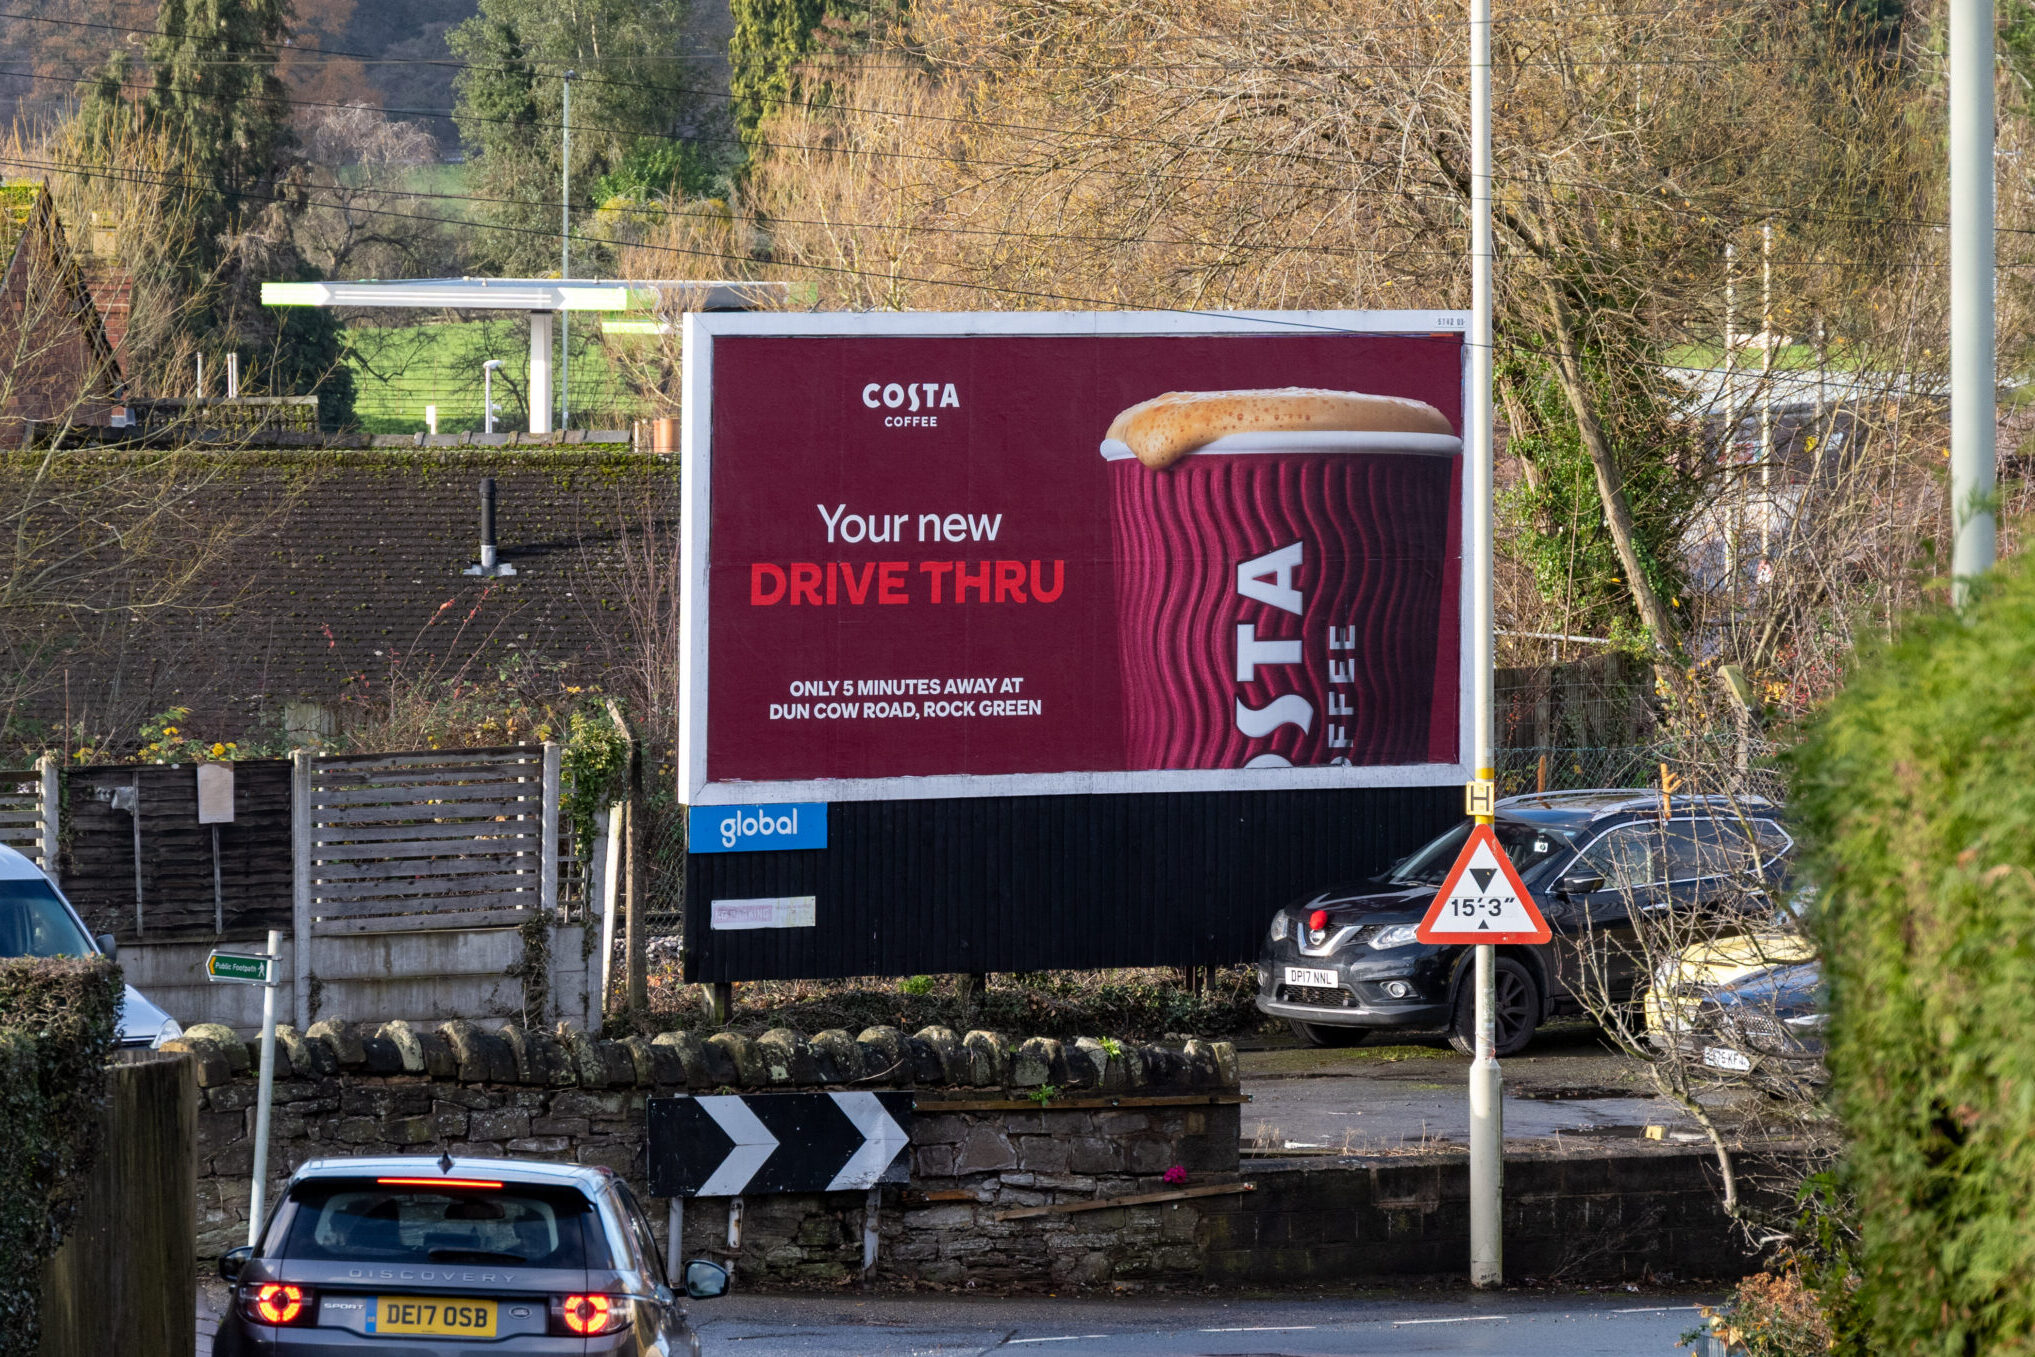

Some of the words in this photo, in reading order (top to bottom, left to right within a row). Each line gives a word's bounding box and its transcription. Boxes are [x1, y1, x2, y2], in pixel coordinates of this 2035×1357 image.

[862, 382, 960, 412] COSTA
[884, 416, 938, 427] COFFEE
[816, 503, 909, 543] Your
[917, 512, 1003, 542] new
[750, 561, 910, 606] DRIVE
[919, 559, 1065, 604] THRU
[1236, 541, 1314, 769] STA
[789, 680, 840, 697] ONLY
[842, 680, 854, 696] 5
[857, 678, 941, 696] MINUTES
[943, 677, 998, 694] AWAY
[1000, 677, 1024, 693] AT
[769, 703, 810, 720] DUN
[813, 702, 860, 719] COW
[863, 701, 920, 720] ROAD,
[923, 700, 976, 717] ROCK
[978, 699, 1042, 716] GREEN
[1470, 785, 1490, 811] H
[720, 808, 798, 848] global
[215, 962, 231, 970] Public
[232, 963, 257, 973] Footpath
[1291, 969, 1311, 983] DP17
[1313, 971, 1332, 985] NNL
[349, 1269, 516, 1283] DISCOVERY
[324, 1302, 364, 1310] SPORT
[386, 1303, 437, 1326] DE17
[443, 1306, 488, 1328] OSB
